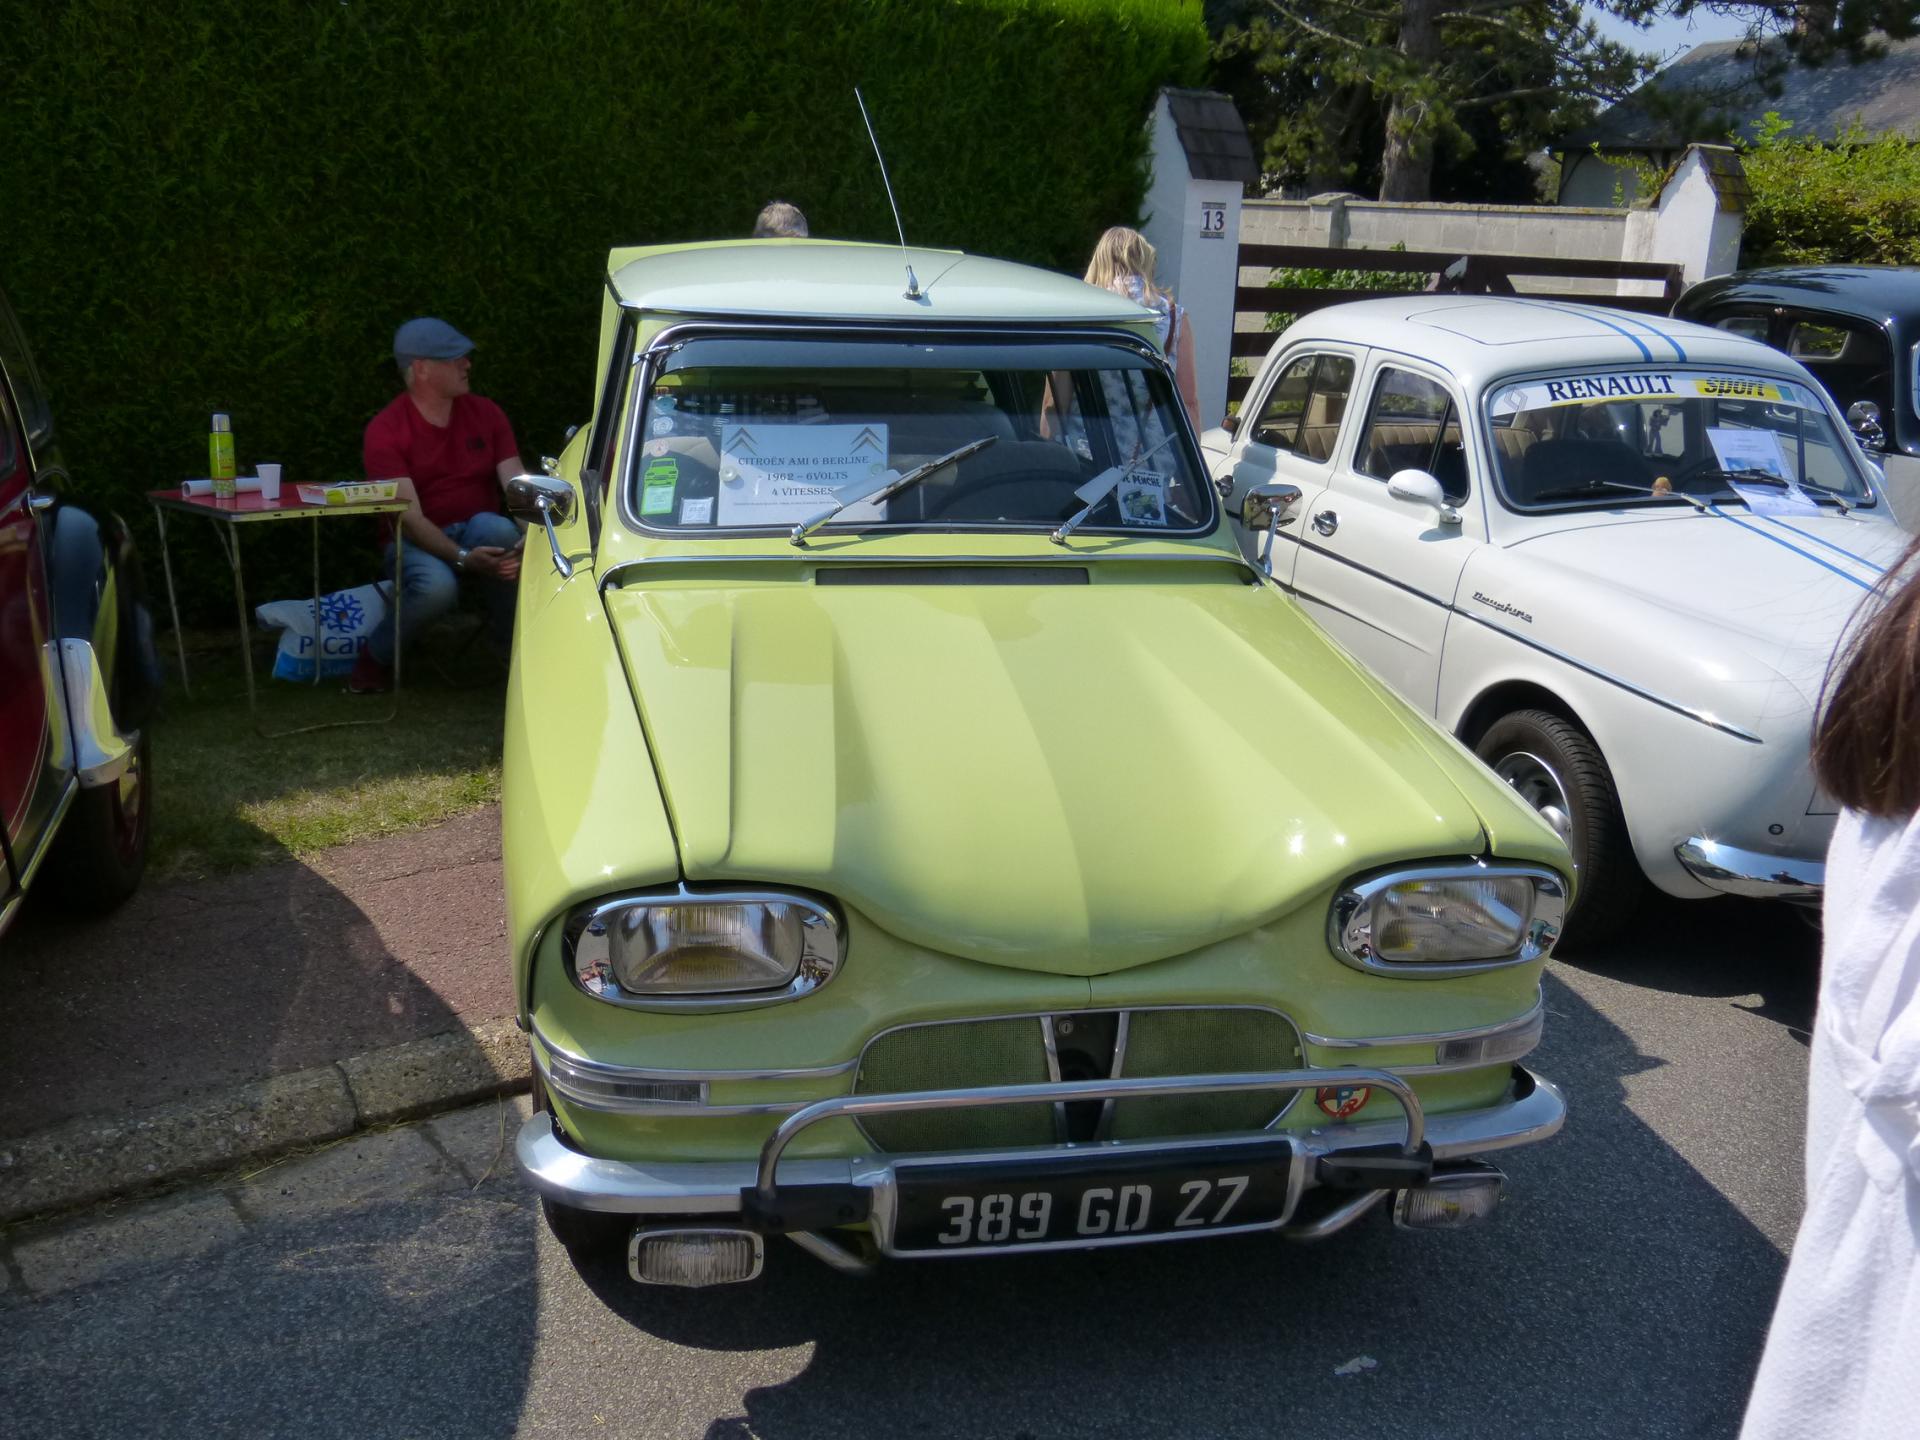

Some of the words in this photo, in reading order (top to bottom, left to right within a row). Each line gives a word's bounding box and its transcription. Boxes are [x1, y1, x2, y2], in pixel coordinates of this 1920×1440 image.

[1202, 209, 1225, 231] 13
[1544, 374, 1675, 401] RENAULT
[1704, 377, 1766, 397] sport
[788, 456, 809, 466] AMI
[812, 456, 819, 466] 6
[822, 455, 870, 465] BERLINE
[767, 472, 795, 481] 1962
[806, 471, 848, 481] 6VOLTS
[782, 487, 834, 496] VITESSES
[938, 1191, 1053, 1244] 389
[1076, 1184, 1152, 1235] GD
[1174, 1175, 1250, 1227] 27
